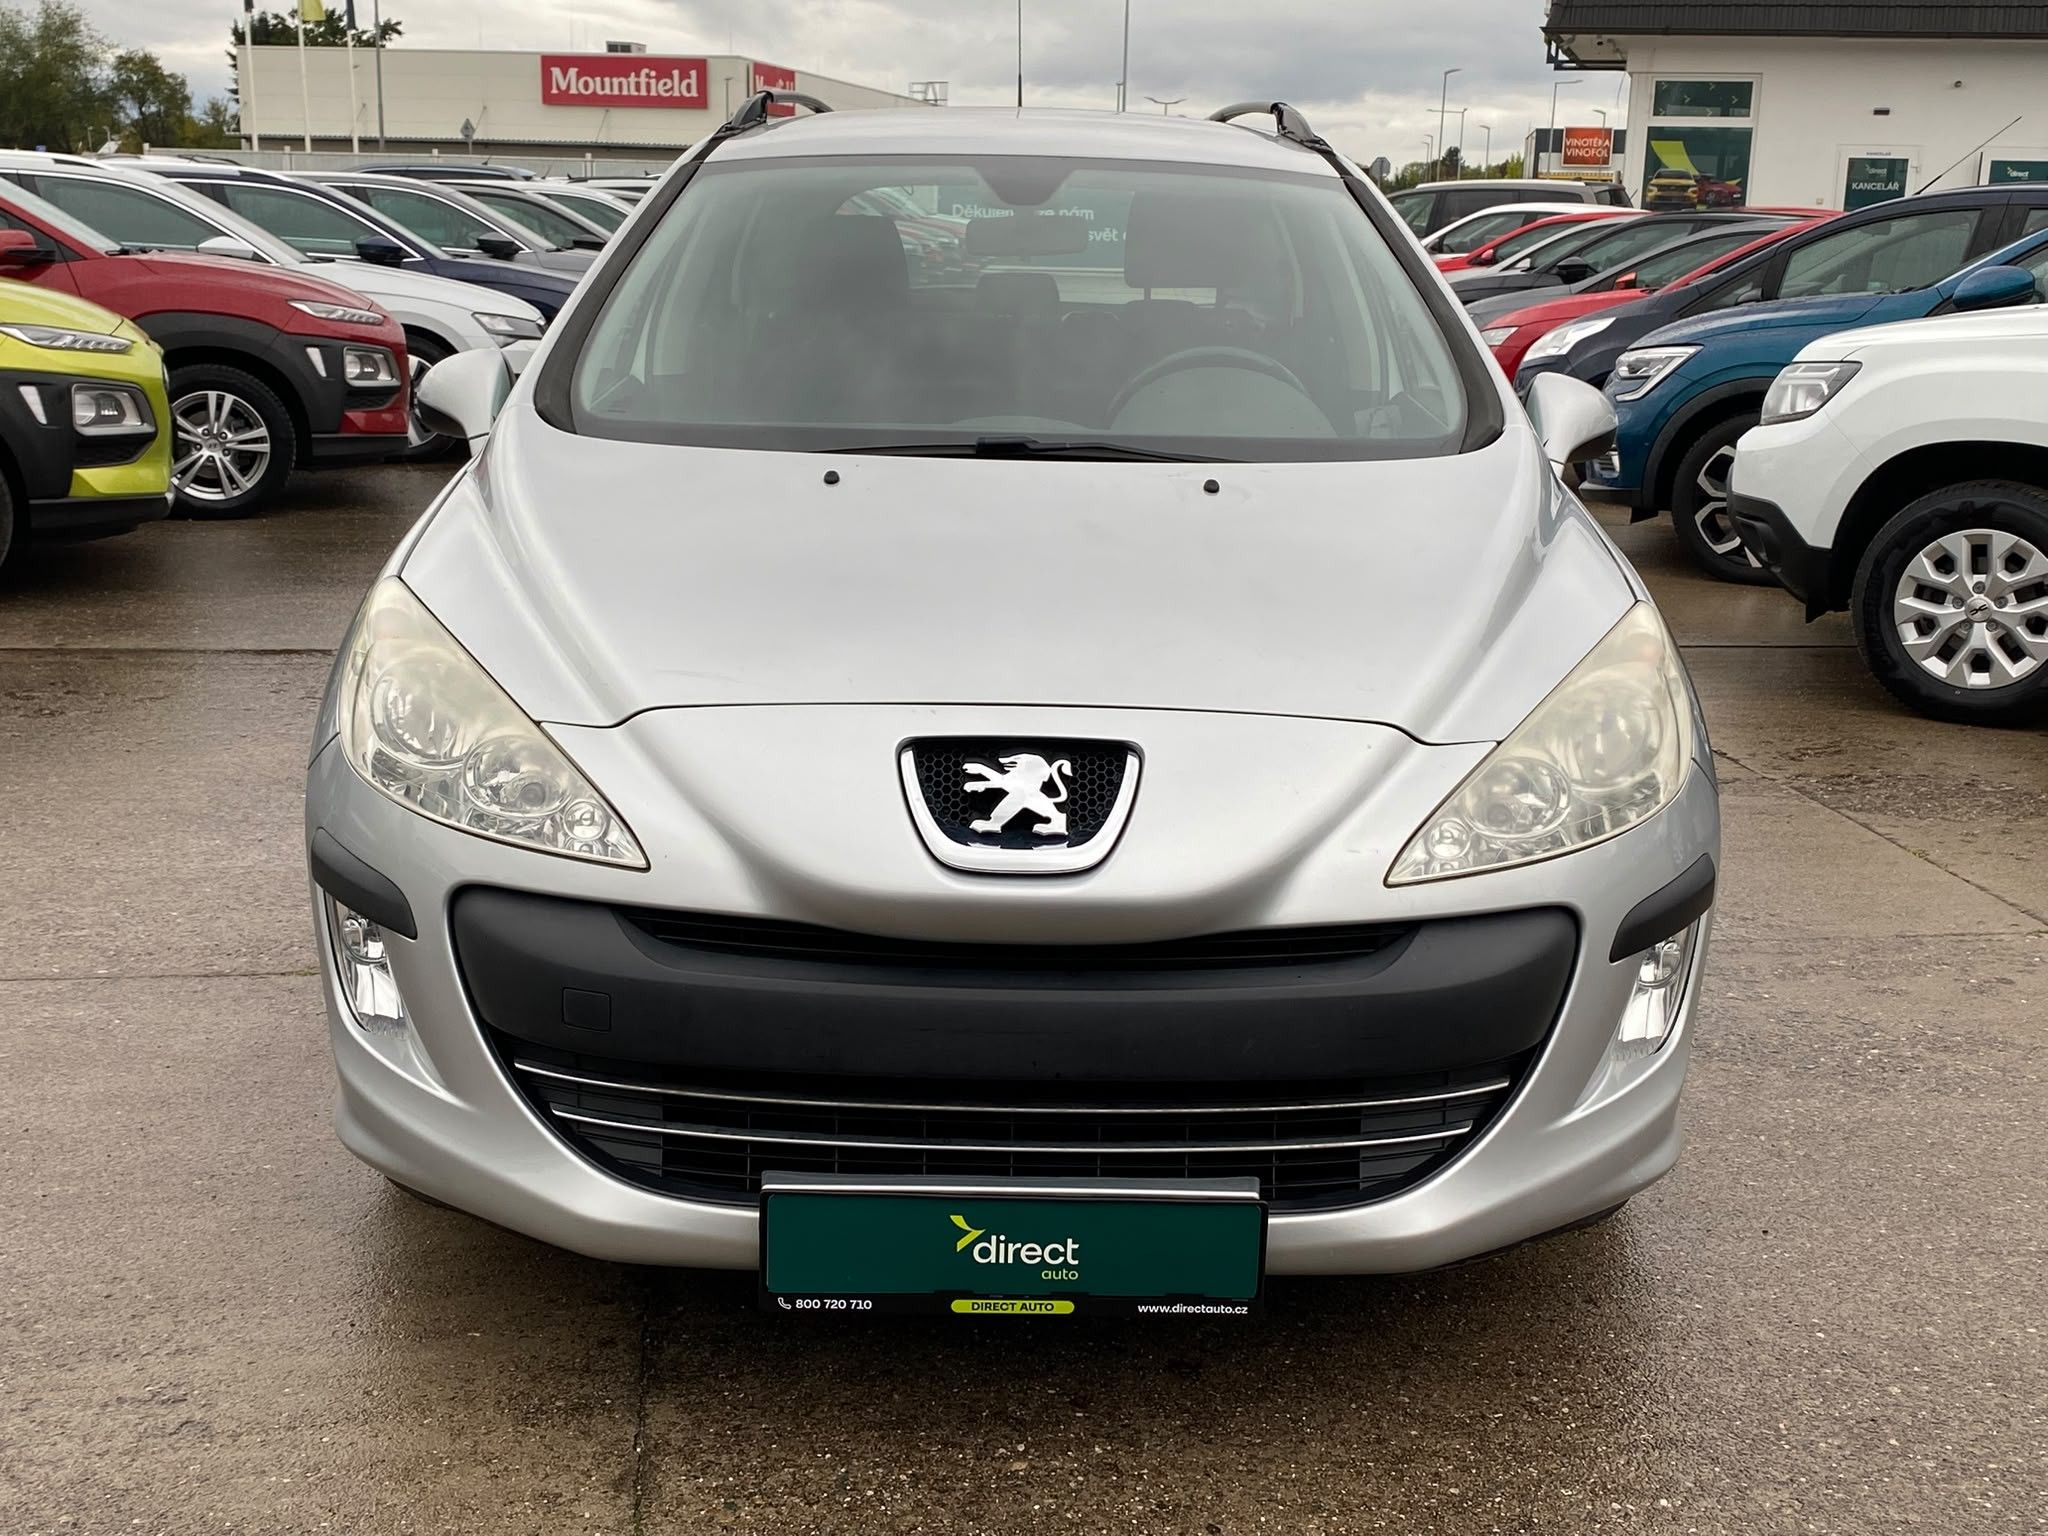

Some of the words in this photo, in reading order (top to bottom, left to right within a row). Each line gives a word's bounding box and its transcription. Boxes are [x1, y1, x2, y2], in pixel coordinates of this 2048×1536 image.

[550, 67, 699, 98] Mountfield
[973, 1234, 1080, 1265] direct
[1041, 1267, 1079, 1280] auto
[795, 1298, 821, 1309] 800
[823, 1299, 847, 1309] 720
[850, 1299, 872, 1310] 710
[971, 1301, 1017, 1312] DIRECT
[1019, 1302, 1055, 1312] AUTO
[1137, 1303, 1249, 1314] www.directauto.cz
